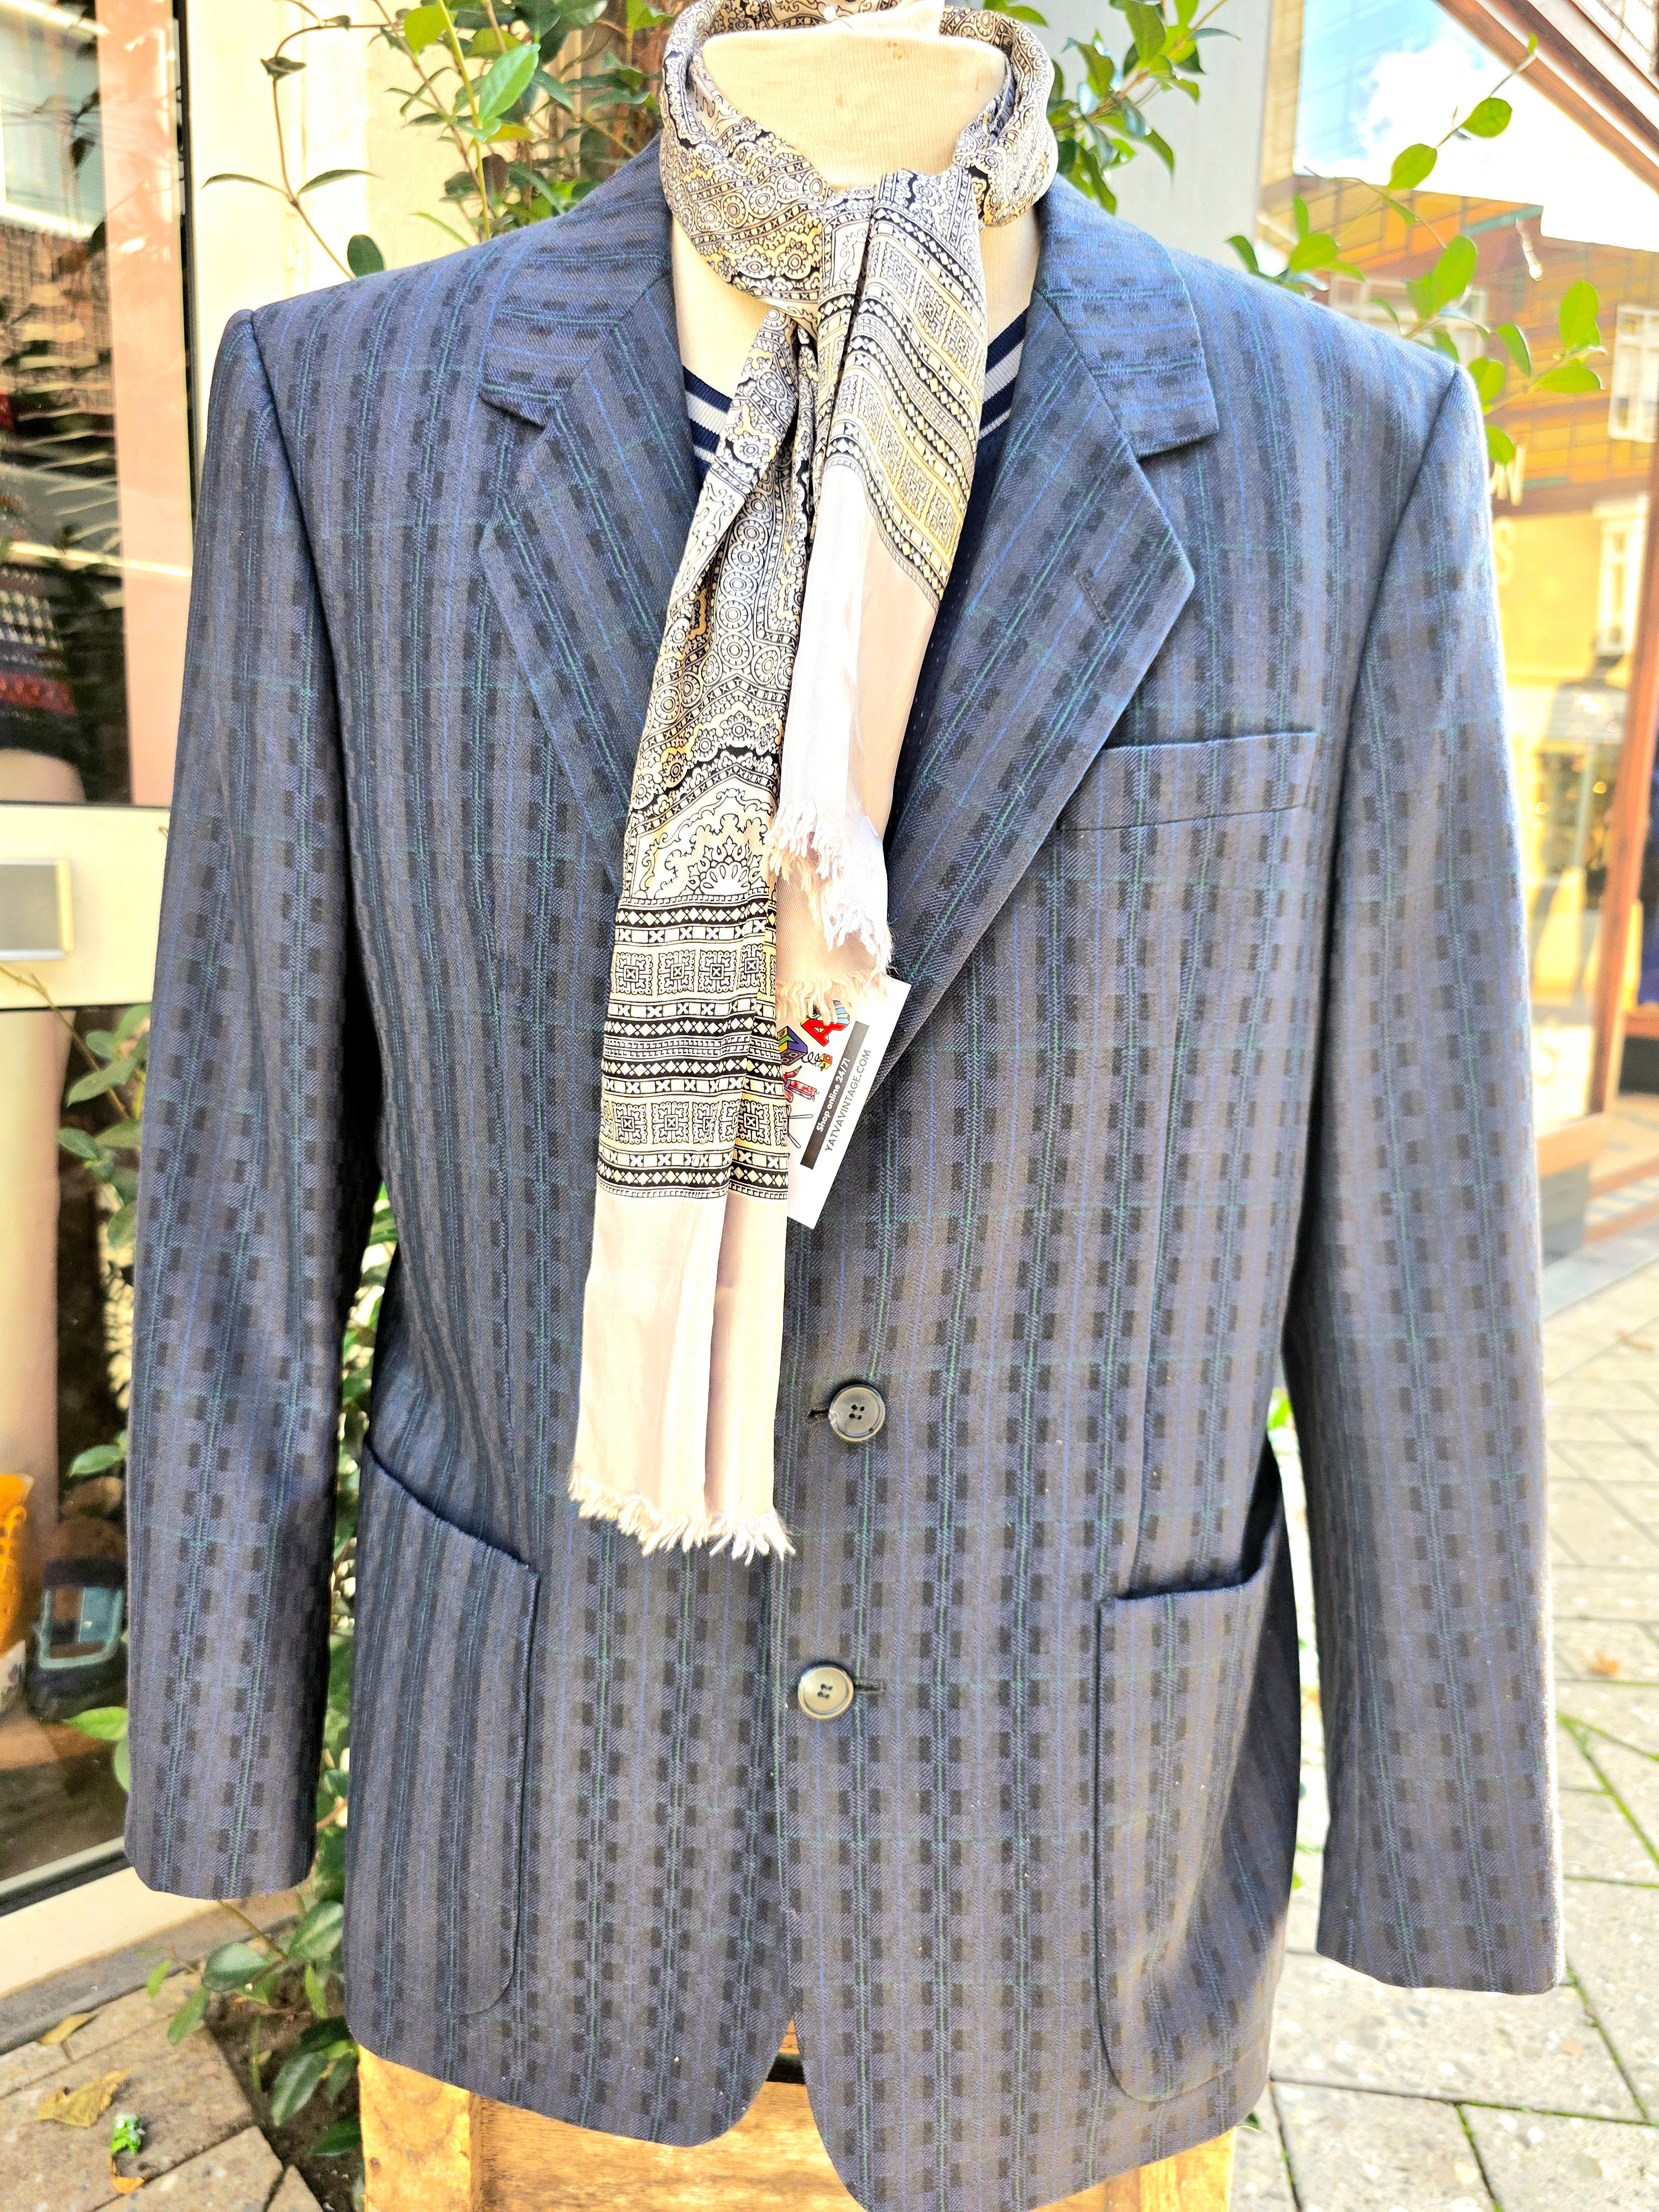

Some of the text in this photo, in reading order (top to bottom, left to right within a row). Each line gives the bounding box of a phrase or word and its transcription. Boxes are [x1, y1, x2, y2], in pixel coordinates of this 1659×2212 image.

[816, 1057, 851, 1133] Shop online 24/7!
[825, 1049, 872, 1151] YATVAVINTAGE.COM
